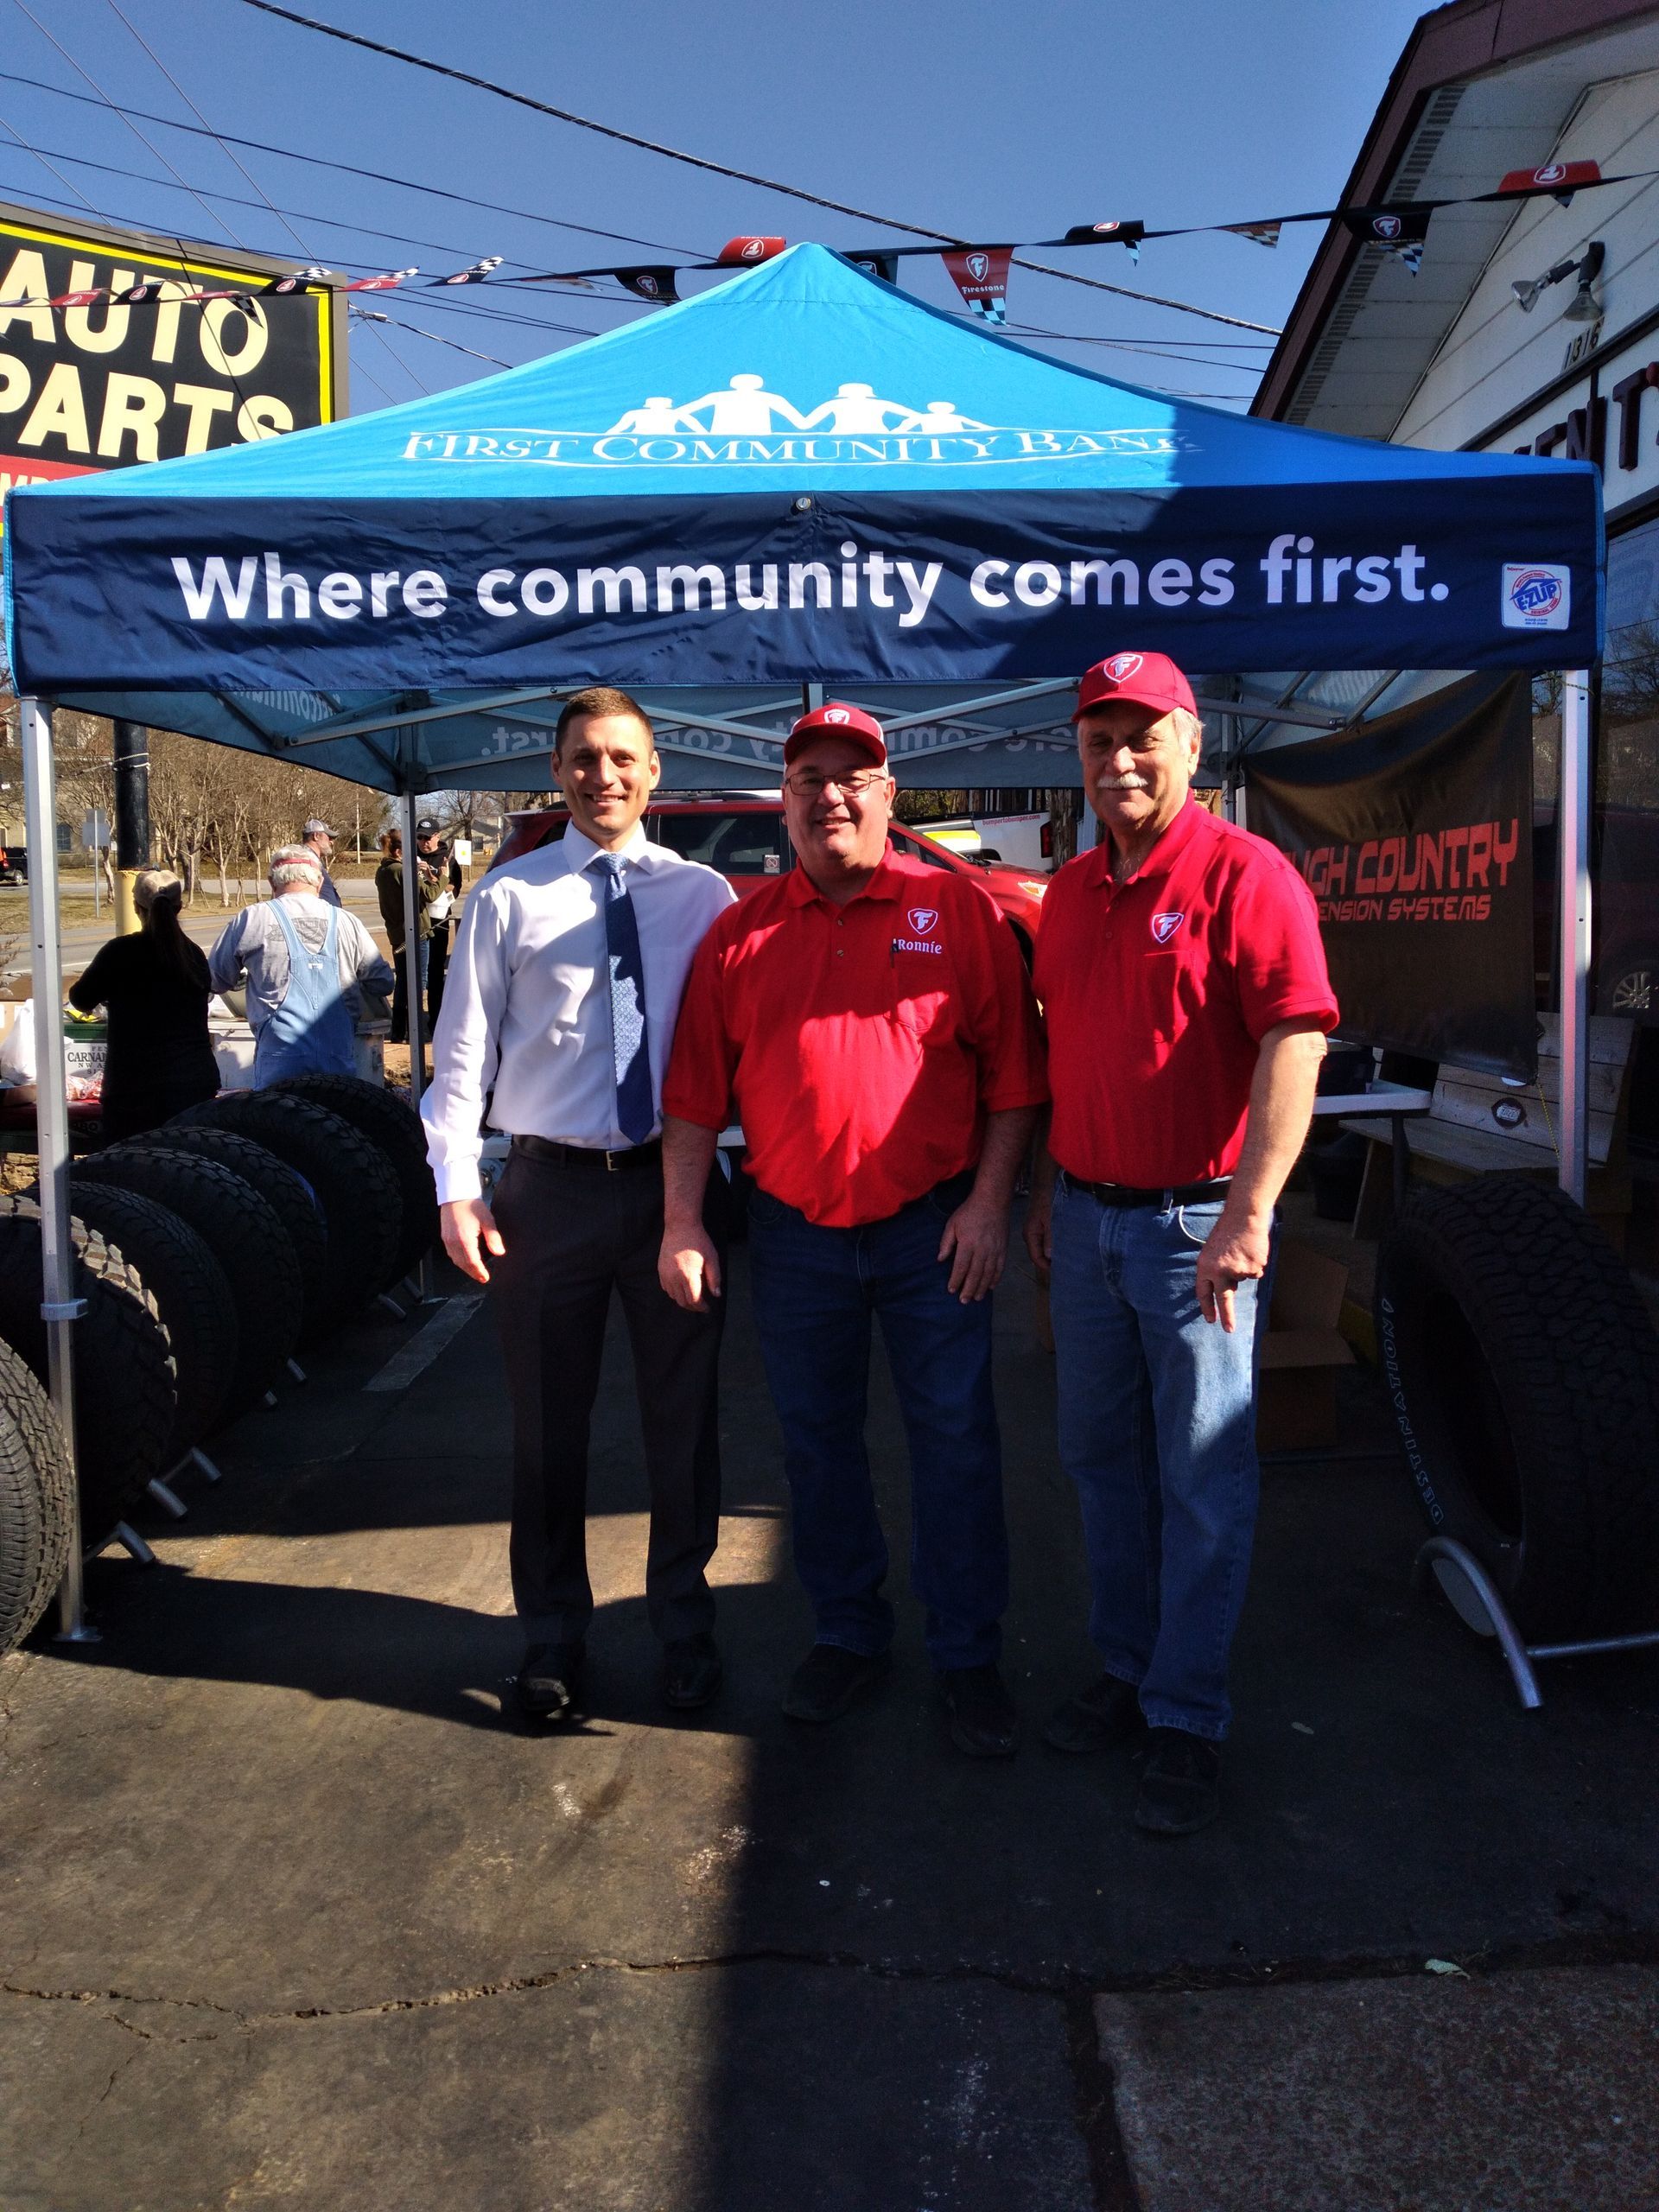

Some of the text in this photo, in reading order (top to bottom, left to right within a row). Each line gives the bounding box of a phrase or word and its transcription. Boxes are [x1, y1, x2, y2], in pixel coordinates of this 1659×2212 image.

[0, 249, 268, 377] AUTO
[962, 284, 1005, 294] Firestone
[397, 432, 1199, 461] FIRST COMMUNITY BANK
[171, 534, 1449, 627] Where community comes first.
[1355, 818, 1518, 895] COUNTRY
[1387, 894, 1491, 922] SYSTEMS
[898, 938, 942, 955] Ronnie
[1382, 1319, 1445, 1526] DESTINATION
